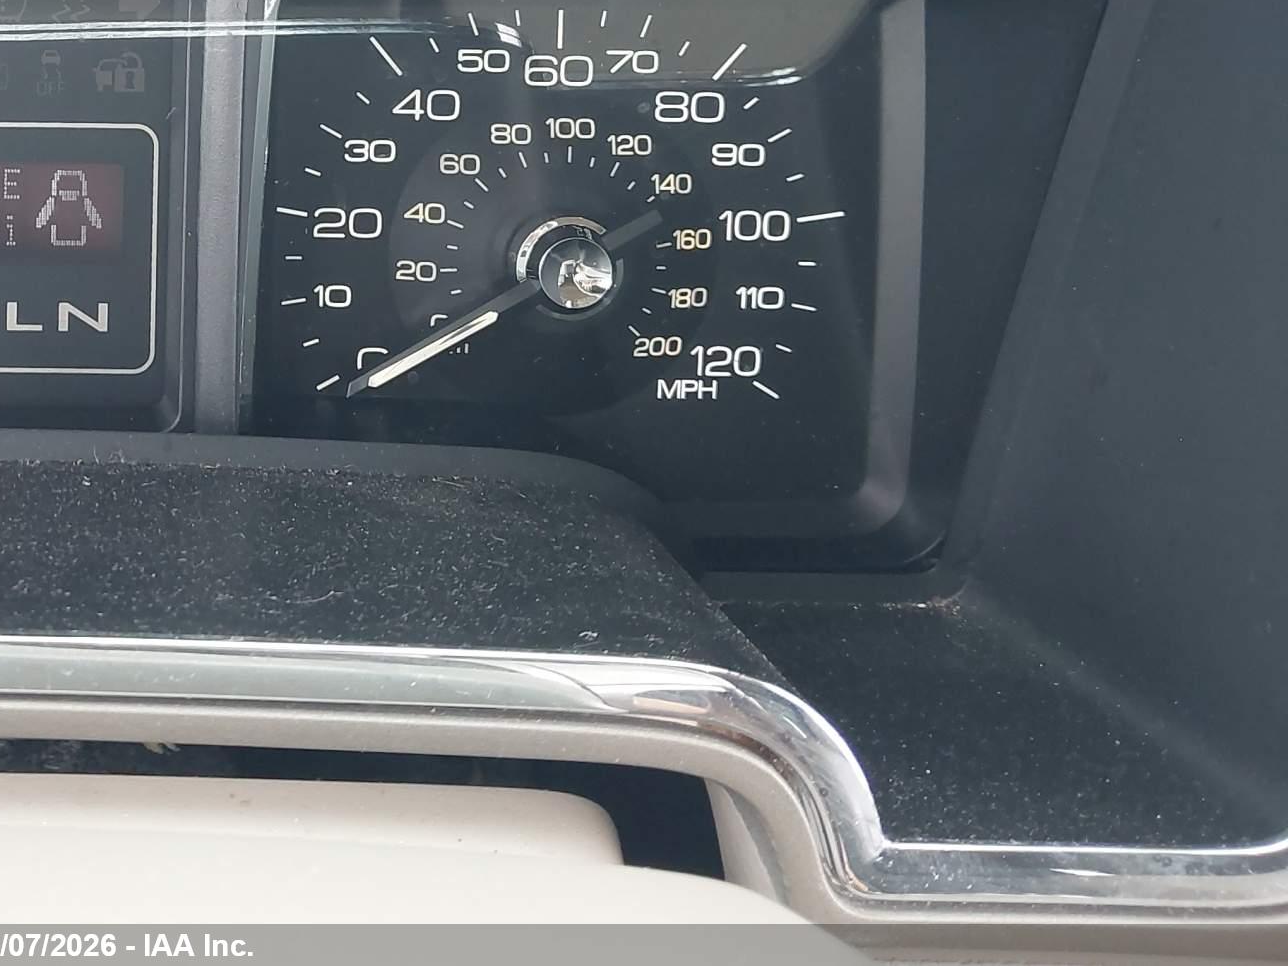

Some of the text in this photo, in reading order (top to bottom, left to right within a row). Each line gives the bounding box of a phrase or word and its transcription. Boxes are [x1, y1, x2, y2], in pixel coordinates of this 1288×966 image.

[457, 49, 511, 73] 50
[524, 55, 594, 87] 60
[605, 49, 659, 74] 70
[392, 89, 461, 121] 40
[654, 91, 725, 123] 80
[490, 123, 532, 145] 80
[545, 117, 596, 139] 100
[344, 139, 396, 163] 30
[607, 134, 652, 156] 120
[711, 143, 766, 167] 90
[439, 153, 481, 175] 60
[4, 169, 20, 200] E
[650, 173, 692, 195] 140
[313, 207, 383, 239] 20
[403, 202, 446, 224] 40
[718, 210, 791, 242] 100
[672, 228, 712, 250] 160
[395, 260, 437, 282] 20
[313, 284, 352, 308] 10
[667, 287, 708, 309] 180
[735, 286, 785, 310] 110
[633, 336, 683, 357] 200
[690, 345, 761, 377] 120
[656, 378, 718, 400] MPH
